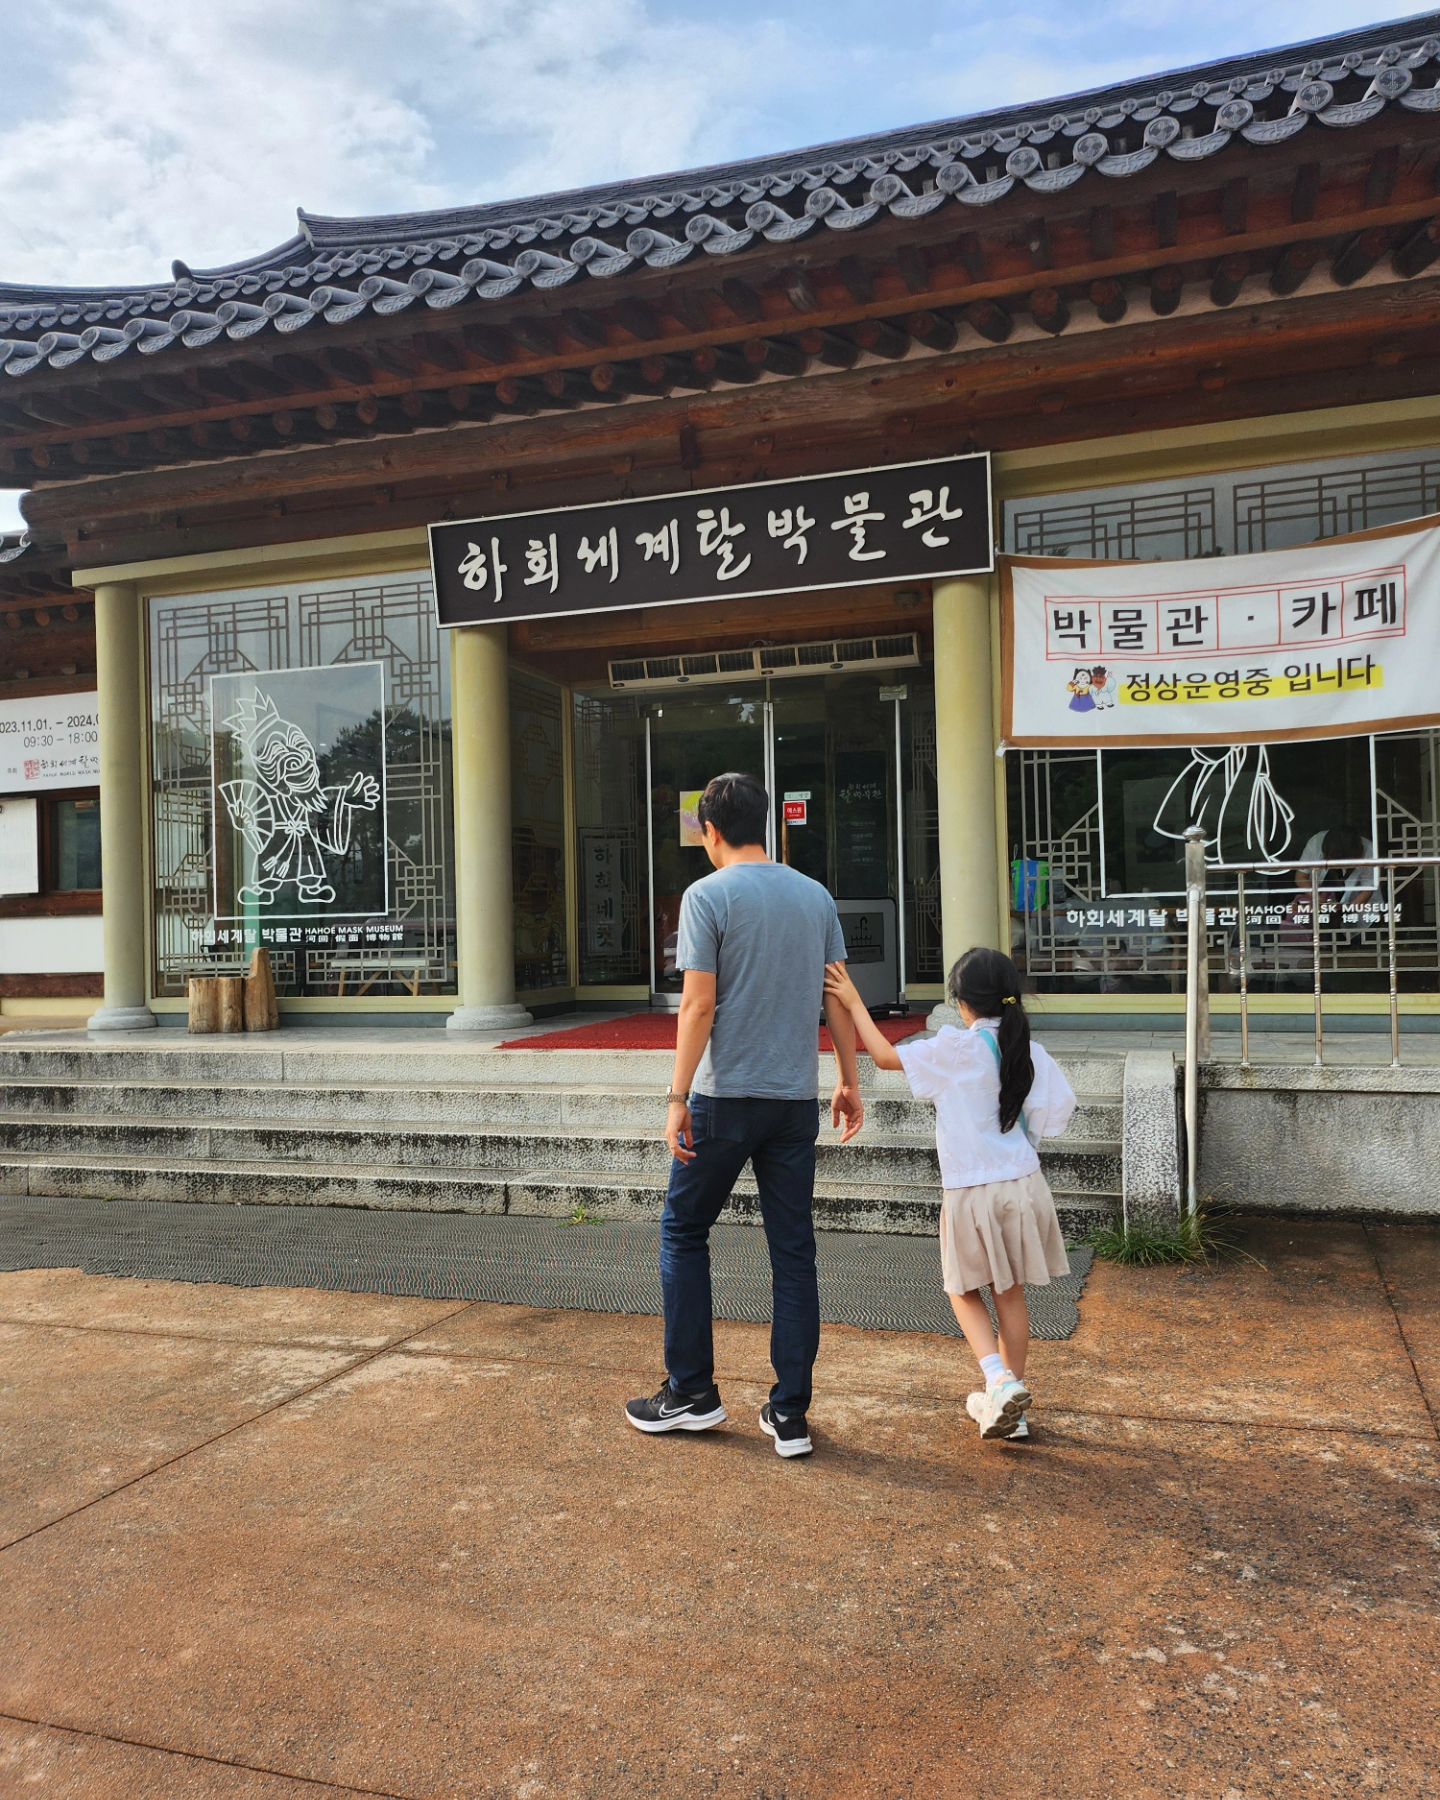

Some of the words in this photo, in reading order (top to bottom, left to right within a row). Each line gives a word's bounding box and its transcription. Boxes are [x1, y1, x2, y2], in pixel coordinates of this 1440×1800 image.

[1053, 606, 1209, 650] 박물관
[1291, 581, 1397, 636] 카페
[1125, 667, 1273, 702] 정상운영중
[1283, 654, 1376, 692] 입니다
[23, 735, 54, 748] 09:30
[68, 731, 98, 744] 18:00
[1066, 908, 1168, 927] 하회세계탈
[1244, 905, 1293, 915] HAHOE
[1341, 903, 1402, 912] MUSEUM
[261, 927, 302, 943] 박물관
[304, 927, 336, 935] HAHOE
[338, 926, 363, 934] MASK
[365, 925, 404, 933] MUSEUM
